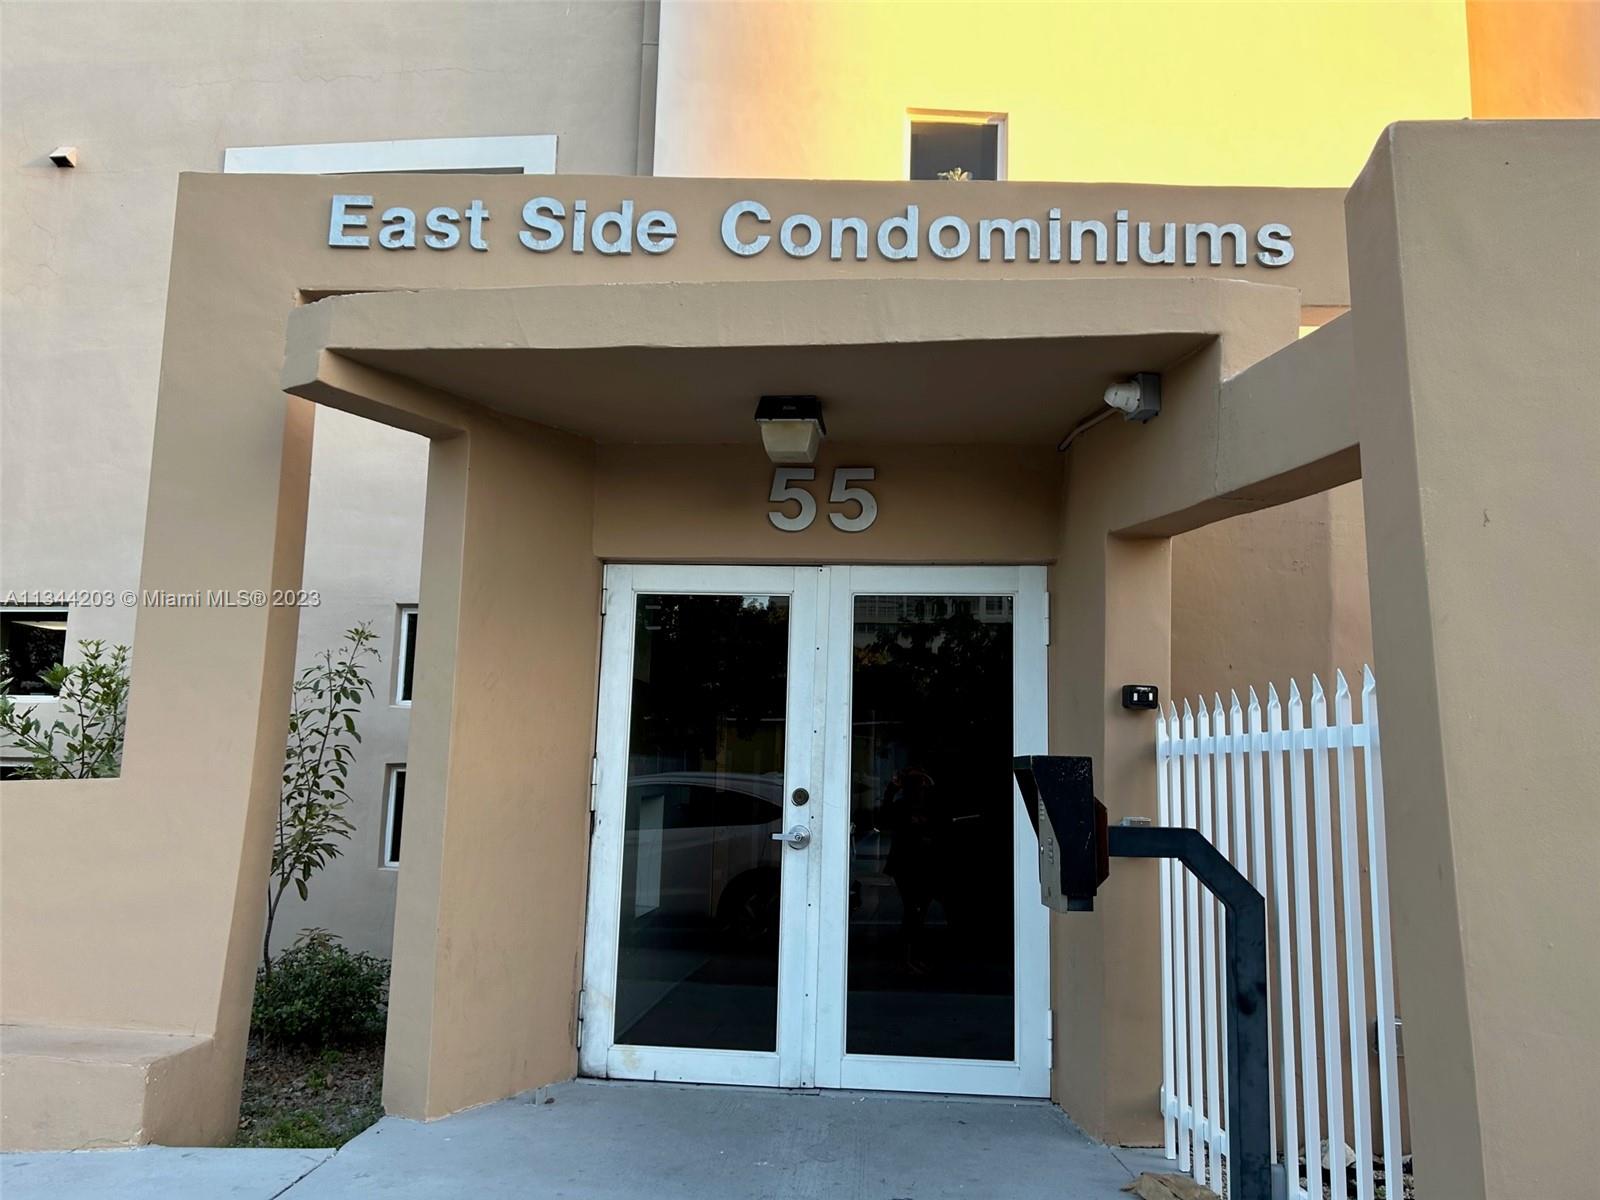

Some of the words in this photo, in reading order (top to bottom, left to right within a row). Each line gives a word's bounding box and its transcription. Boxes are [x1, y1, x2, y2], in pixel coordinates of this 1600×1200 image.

[328, 194, 490, 252] East
[518, 195, 678, 255] Side
[720, 199, 1295, 268] Condominiums
[767, 467, 878, 533] 55
